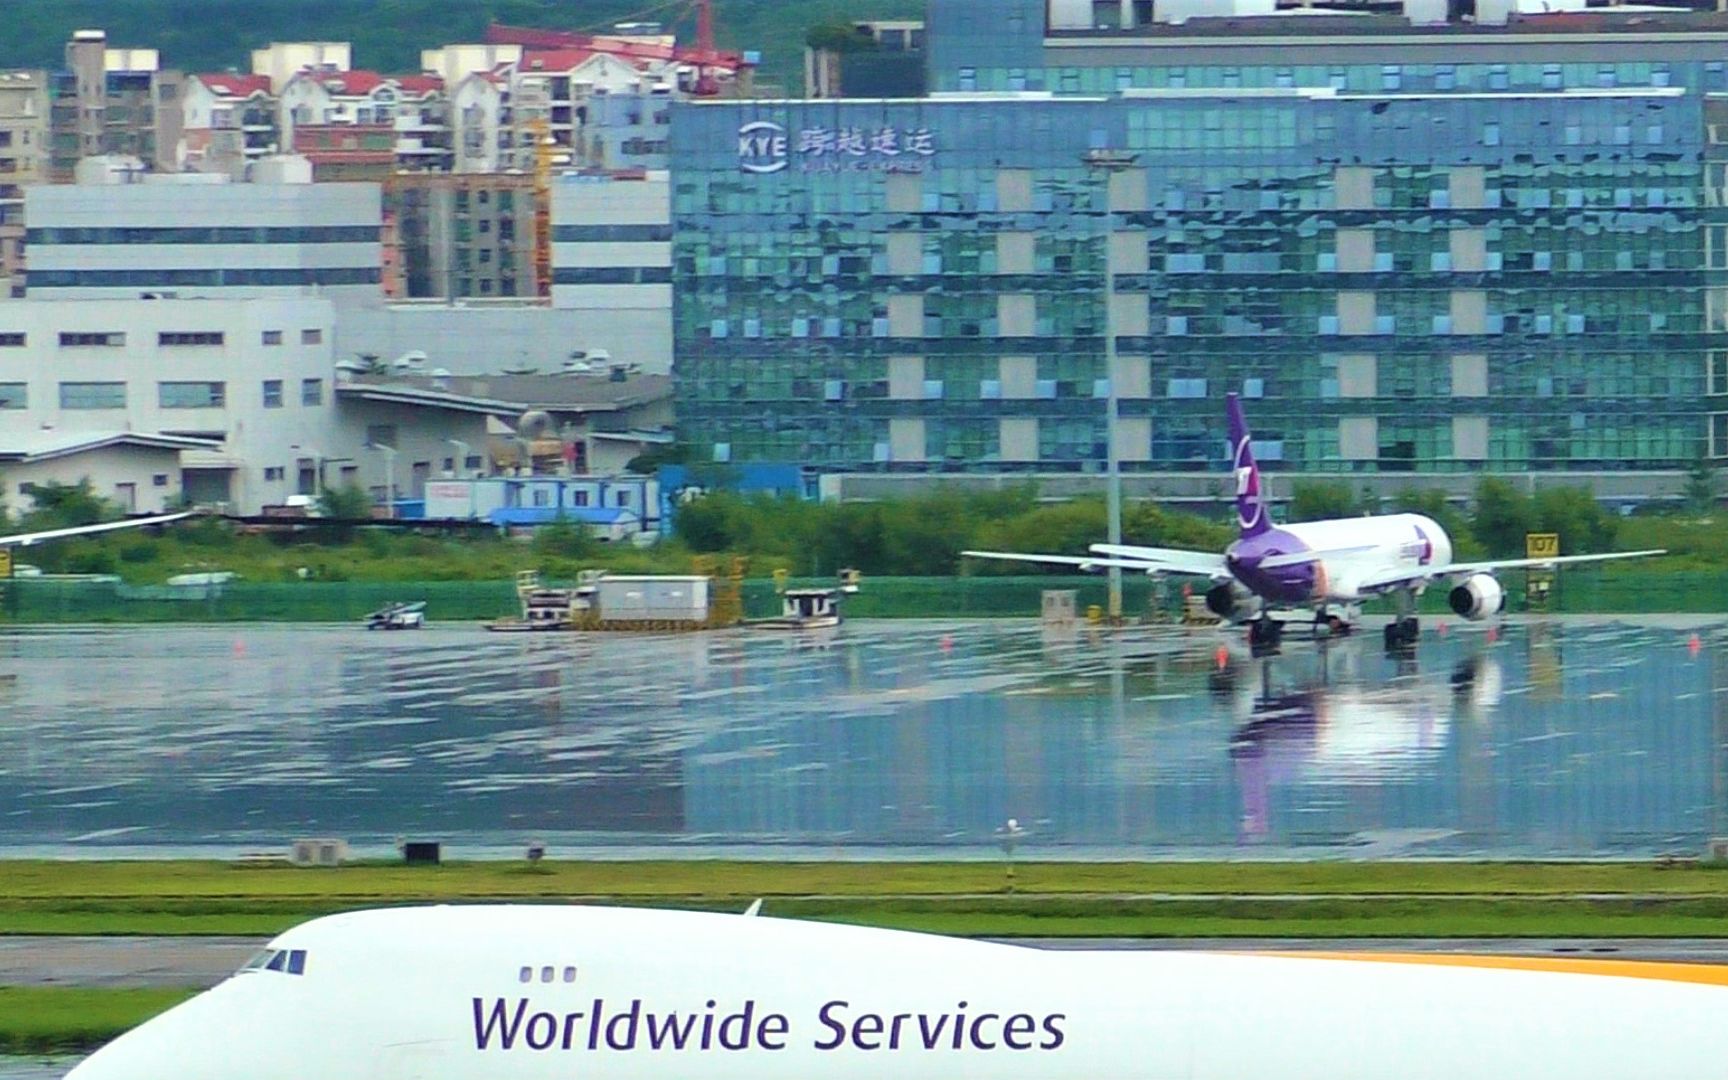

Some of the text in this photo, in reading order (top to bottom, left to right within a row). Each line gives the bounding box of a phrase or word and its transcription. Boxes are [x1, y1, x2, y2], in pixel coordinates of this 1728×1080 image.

[738, 136, 788, 157] KYE
[1528, 535, 1556, 552] 107
[472, 997, 1067, 1051] Worldwide Services
